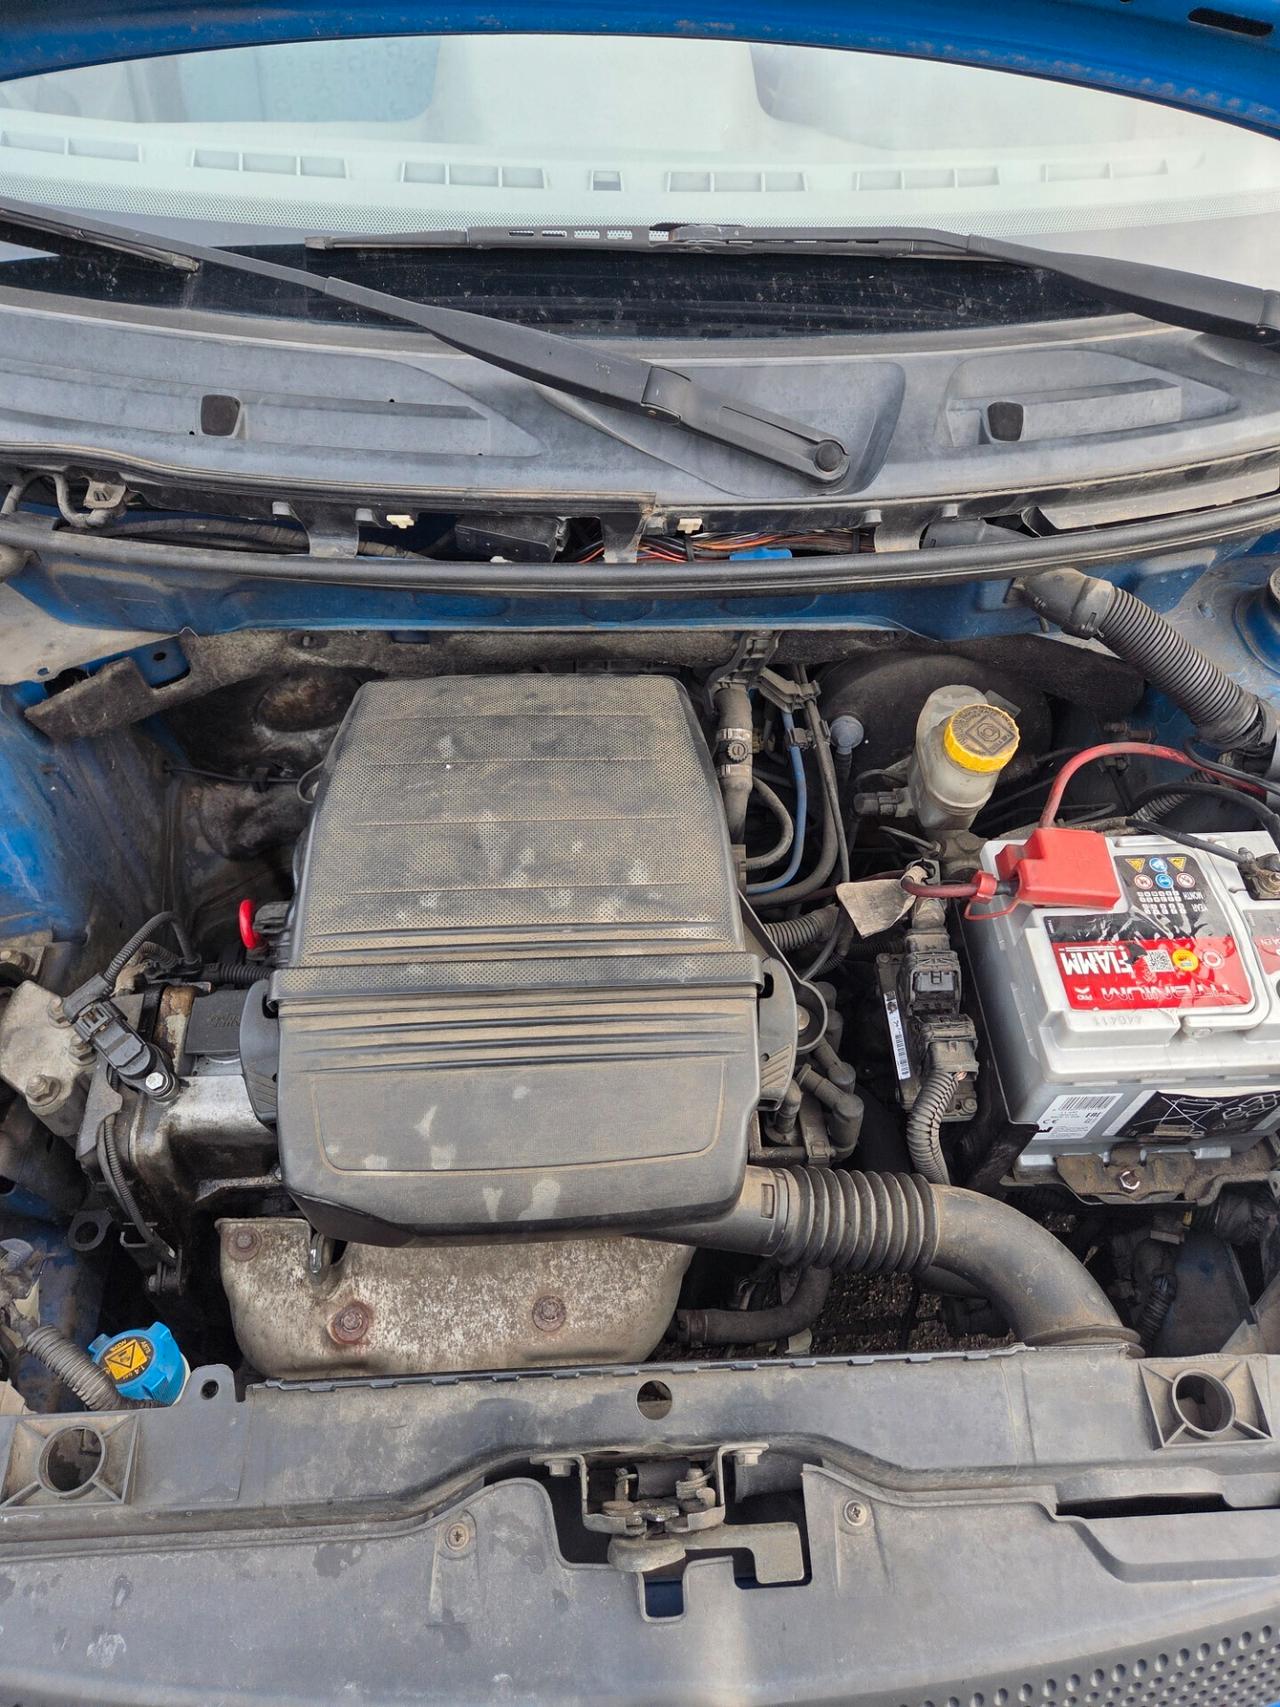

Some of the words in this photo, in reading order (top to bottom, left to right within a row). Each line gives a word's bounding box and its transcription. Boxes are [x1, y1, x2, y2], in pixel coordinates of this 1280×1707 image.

[1182, 891, 1204, 900] MONTH
[1191, 903, 1208, 912] YEAR
[1060, 951, 1133, 976] FIAMM
